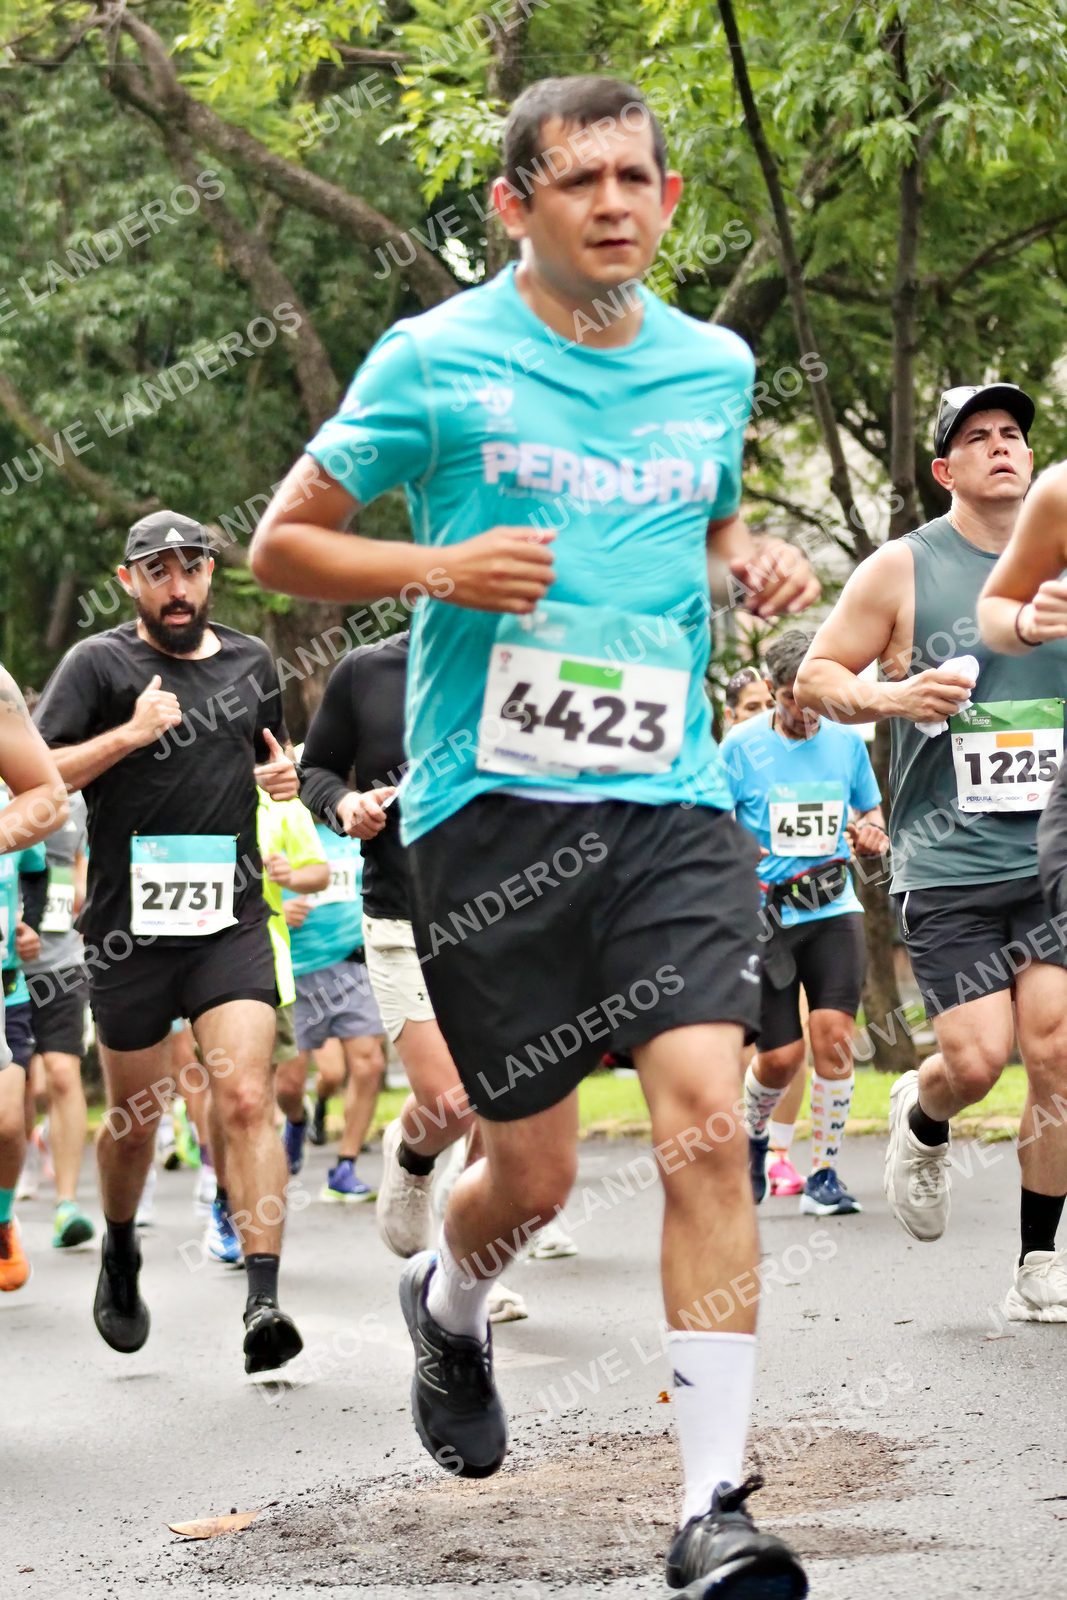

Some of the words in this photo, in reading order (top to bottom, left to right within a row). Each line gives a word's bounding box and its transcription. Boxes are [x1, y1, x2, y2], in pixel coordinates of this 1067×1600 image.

[500, 681, 667, 753] 4423
[964, 748, 1059, 785] 1225
[777, 815, 838, 837] 4515
[141, 881, 223, 910] 2731
